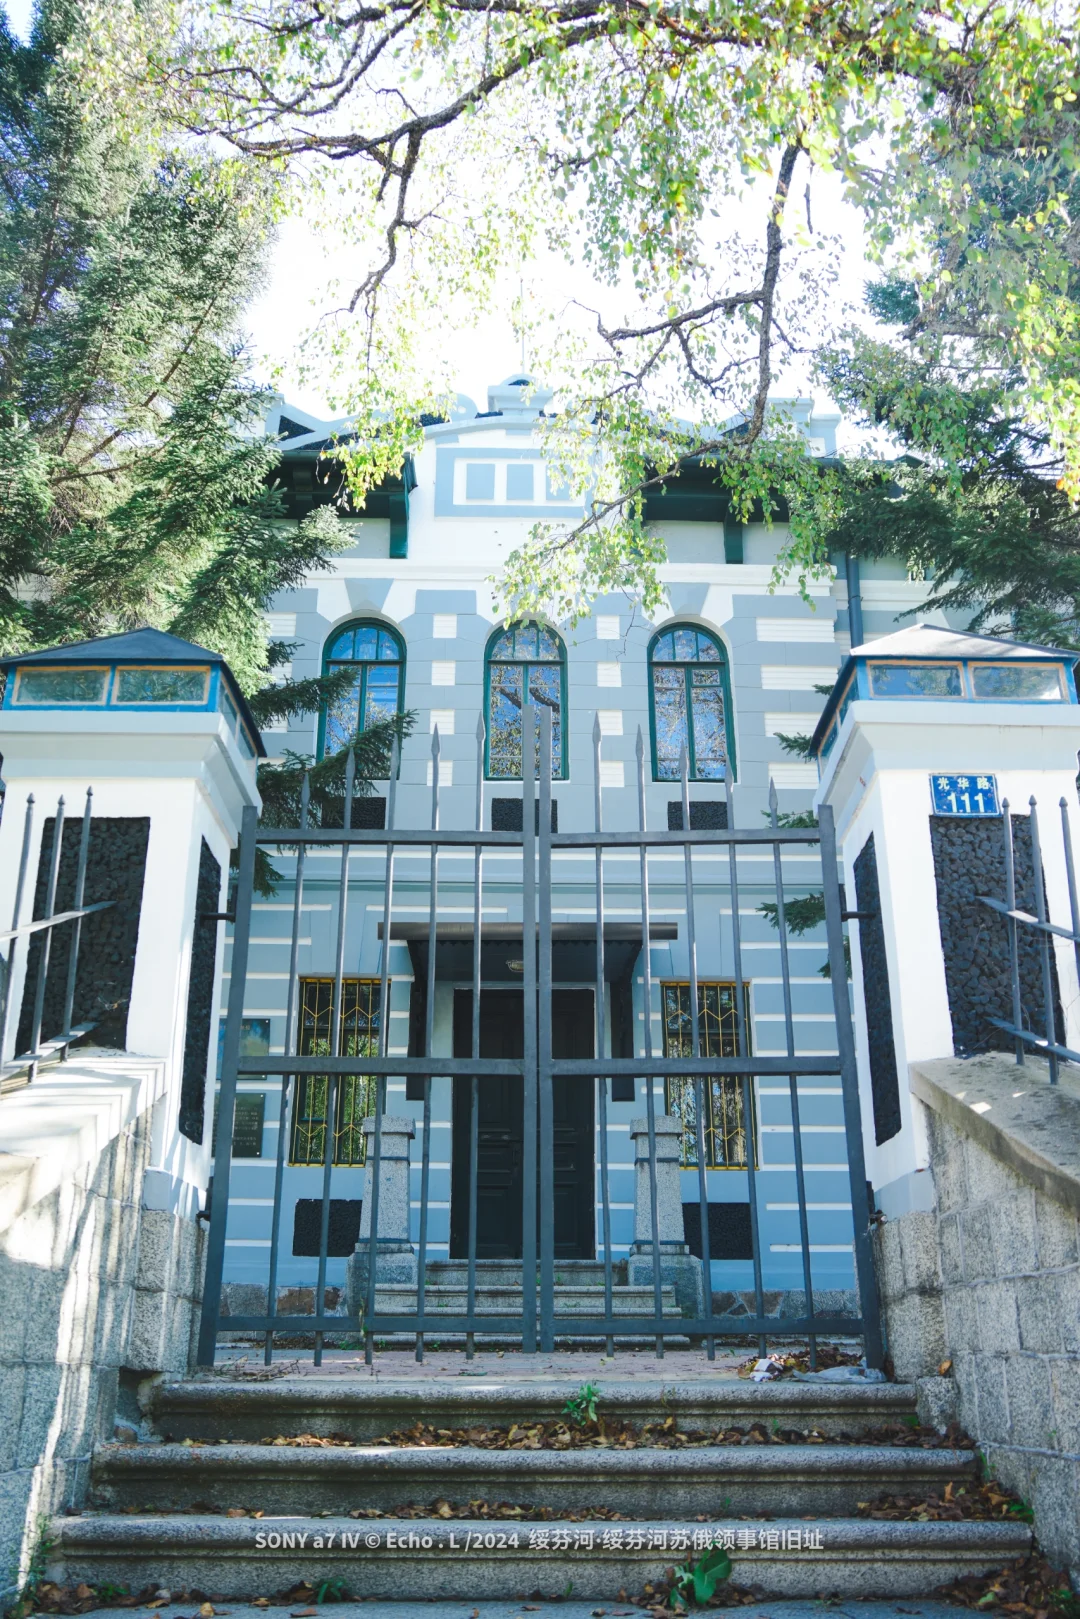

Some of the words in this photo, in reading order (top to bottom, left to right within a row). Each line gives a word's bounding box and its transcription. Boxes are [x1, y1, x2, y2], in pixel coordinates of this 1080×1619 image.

[937, 777, 989, 790] 光华路
[947, 792, 985, 813] 111
